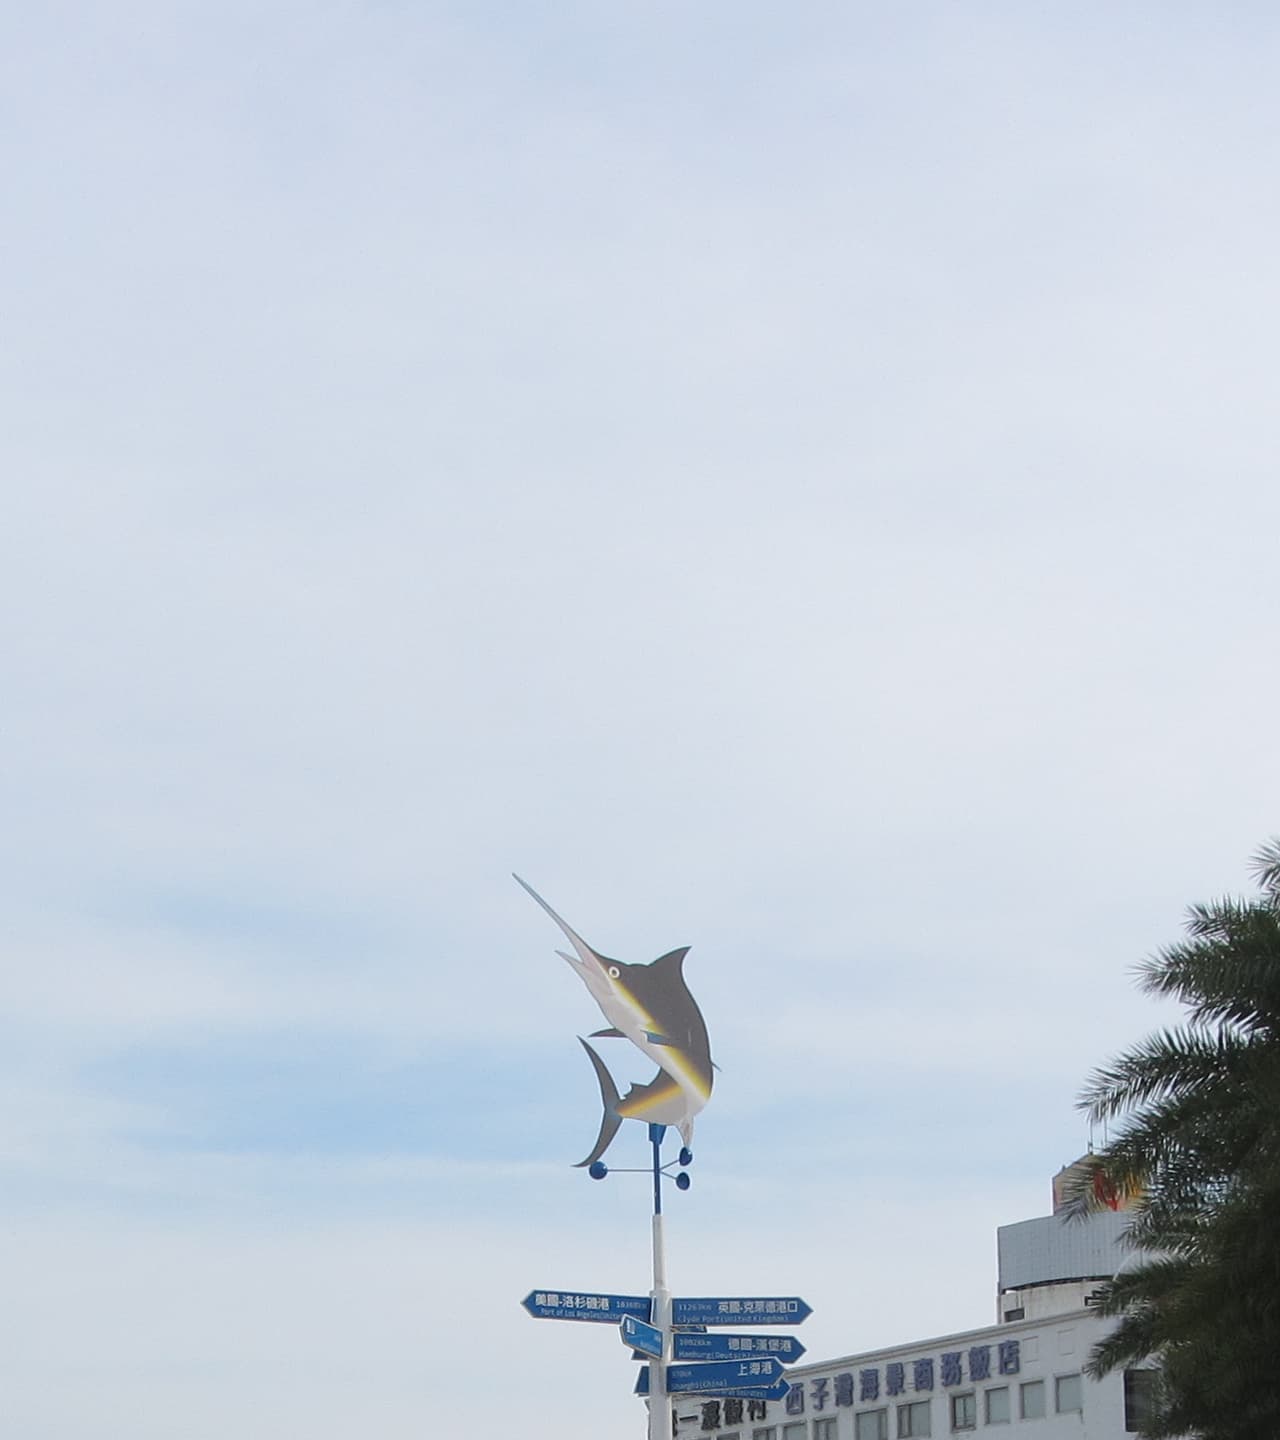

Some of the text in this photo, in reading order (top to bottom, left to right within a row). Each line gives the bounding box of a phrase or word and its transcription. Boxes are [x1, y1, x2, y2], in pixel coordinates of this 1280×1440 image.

[737, 1361, 772, 1377] 上海港
[785, 1339, 1020, 1415] 西子灣海景商務飯店
